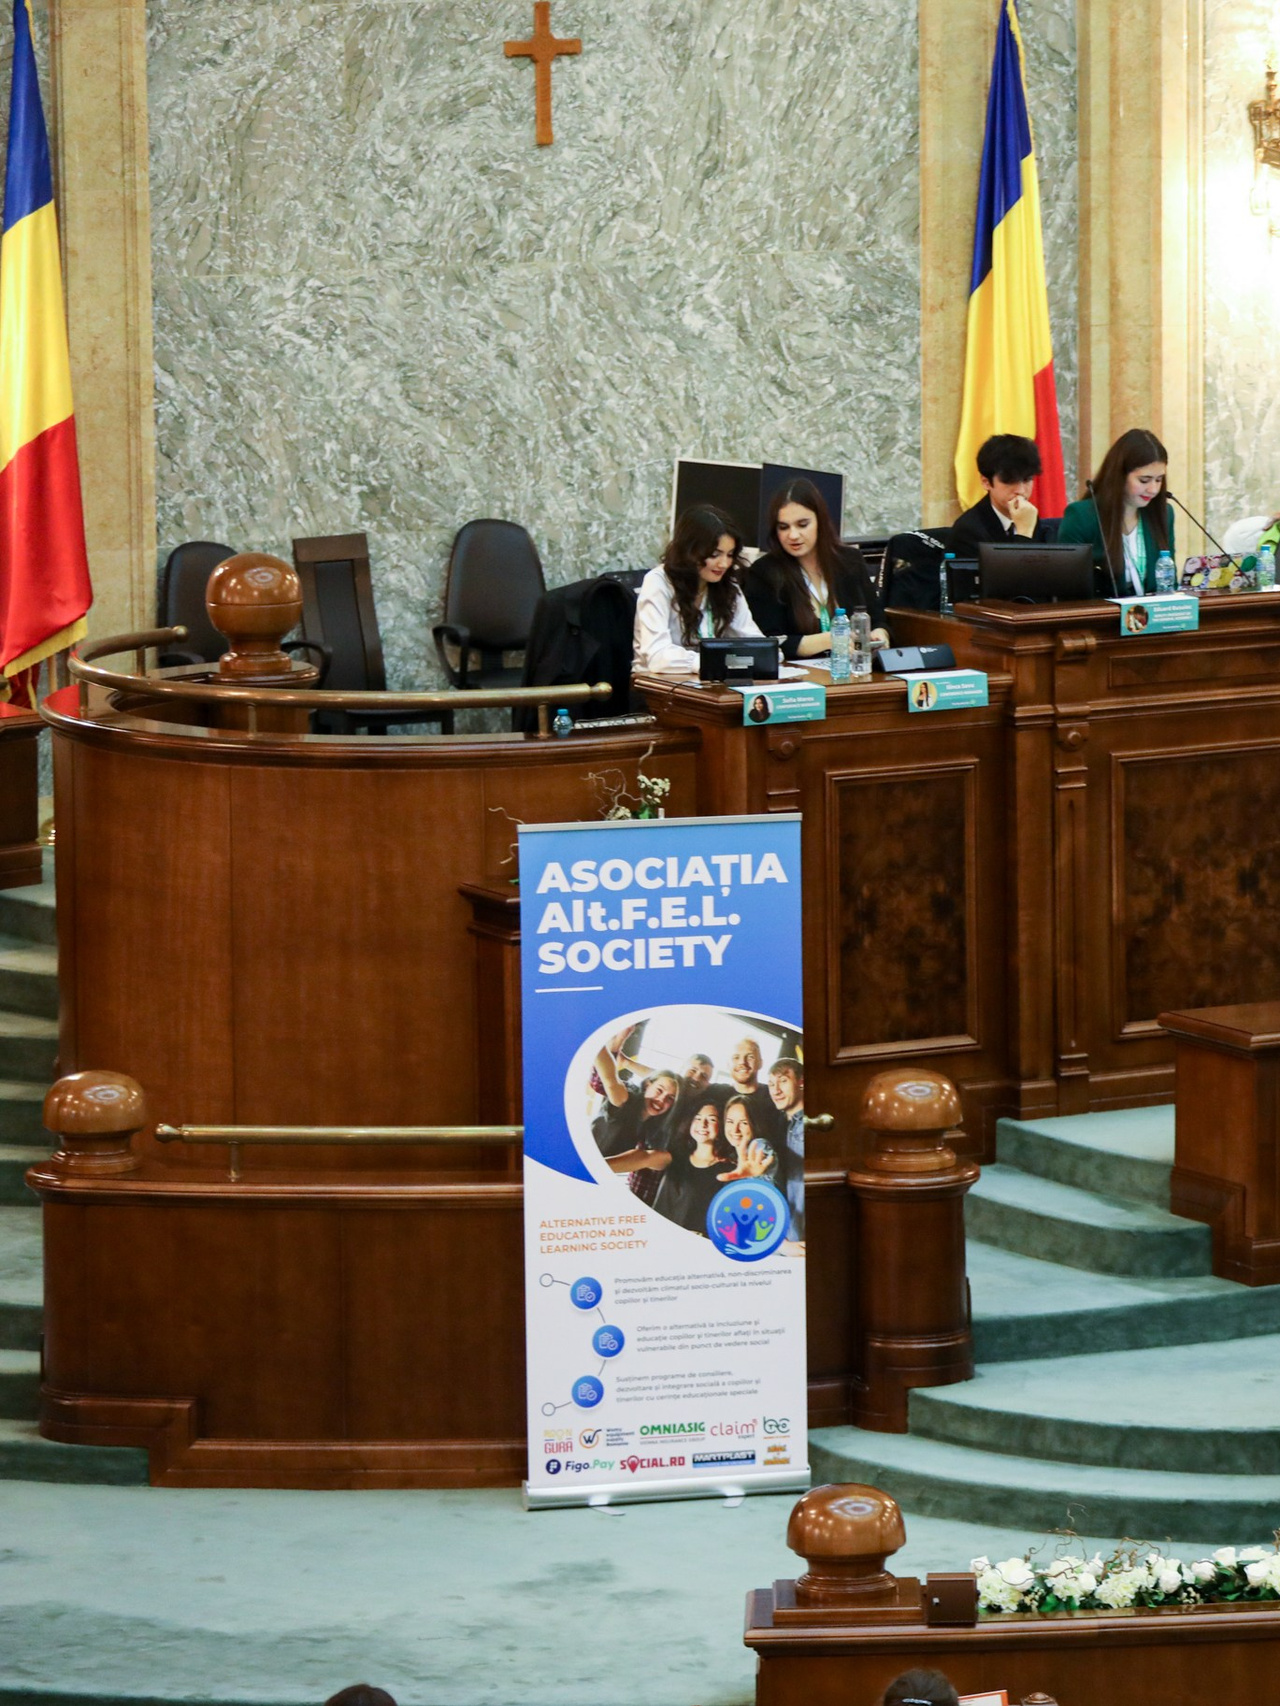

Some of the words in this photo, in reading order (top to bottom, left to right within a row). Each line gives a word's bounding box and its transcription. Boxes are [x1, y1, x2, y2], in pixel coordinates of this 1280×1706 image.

[536, 852, 789, 897] ASOCIAȚIA
[536, 895, 741, 934] Alt.F.E.L.
[538, 935, 733, 974] SOCIETY
[540, 1216, 615, 1229] ALTERNATIVE
[618, 1214, 647, 1224] FREE
[540, 1229, 606, 1241] EDUCATION
[610, 1228, 635, 1237] AND
[540, 1242, 597, 1254] LEARNING
[600, 1240, 648, 1251] SOCIETY
[640, 1421, 705, 1436] OMNIASIG
[710, 1421, 755, 1436] claim
[565, 1459, 616, 1473] Figo.Pay
